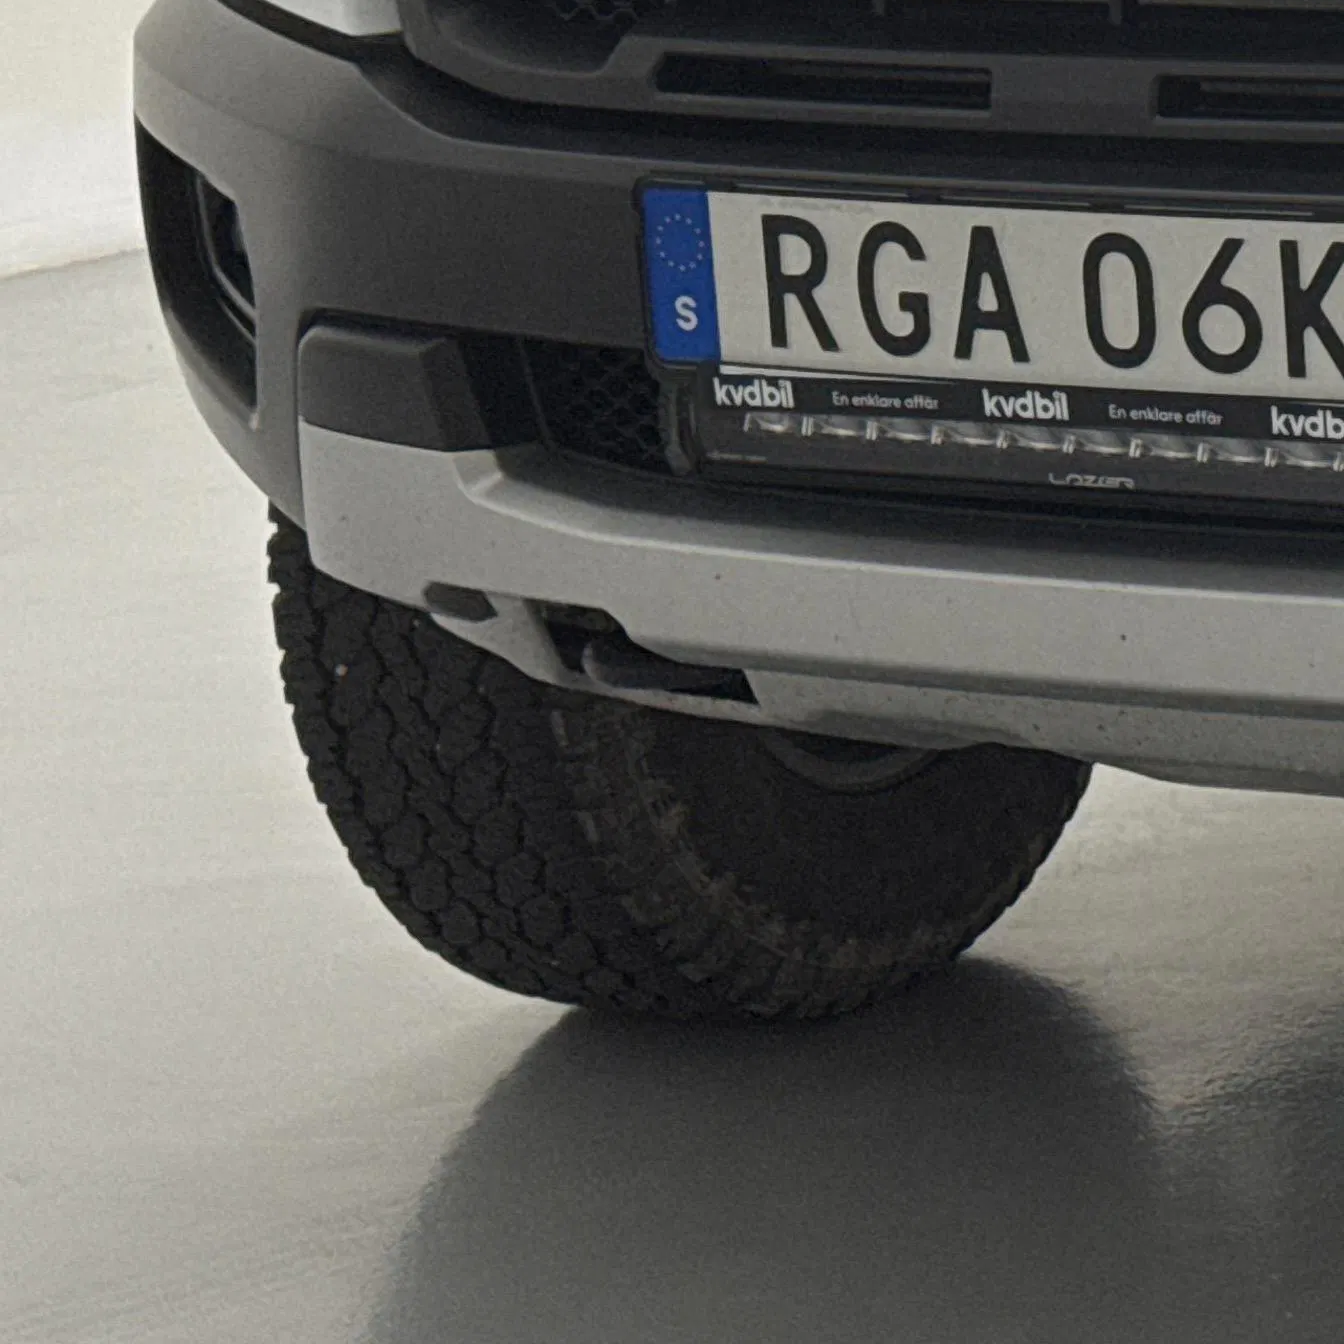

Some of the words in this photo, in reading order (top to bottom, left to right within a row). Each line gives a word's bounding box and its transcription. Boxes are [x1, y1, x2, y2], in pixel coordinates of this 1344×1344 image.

[761, 214, 1031, 362] RGA
[675, 296, 698, 331] S
[713, 377, 795, 408] kvdbil
[832, 391, 849, 406] En
[851, 394, 901, 408] enklare
[982, 388, 1070, 421] kvdbil
[1108, 404, 1127, 419] En
[1130, 405, 1183, 423] enklare
[1048, 472, 1136, 490] LAZER
